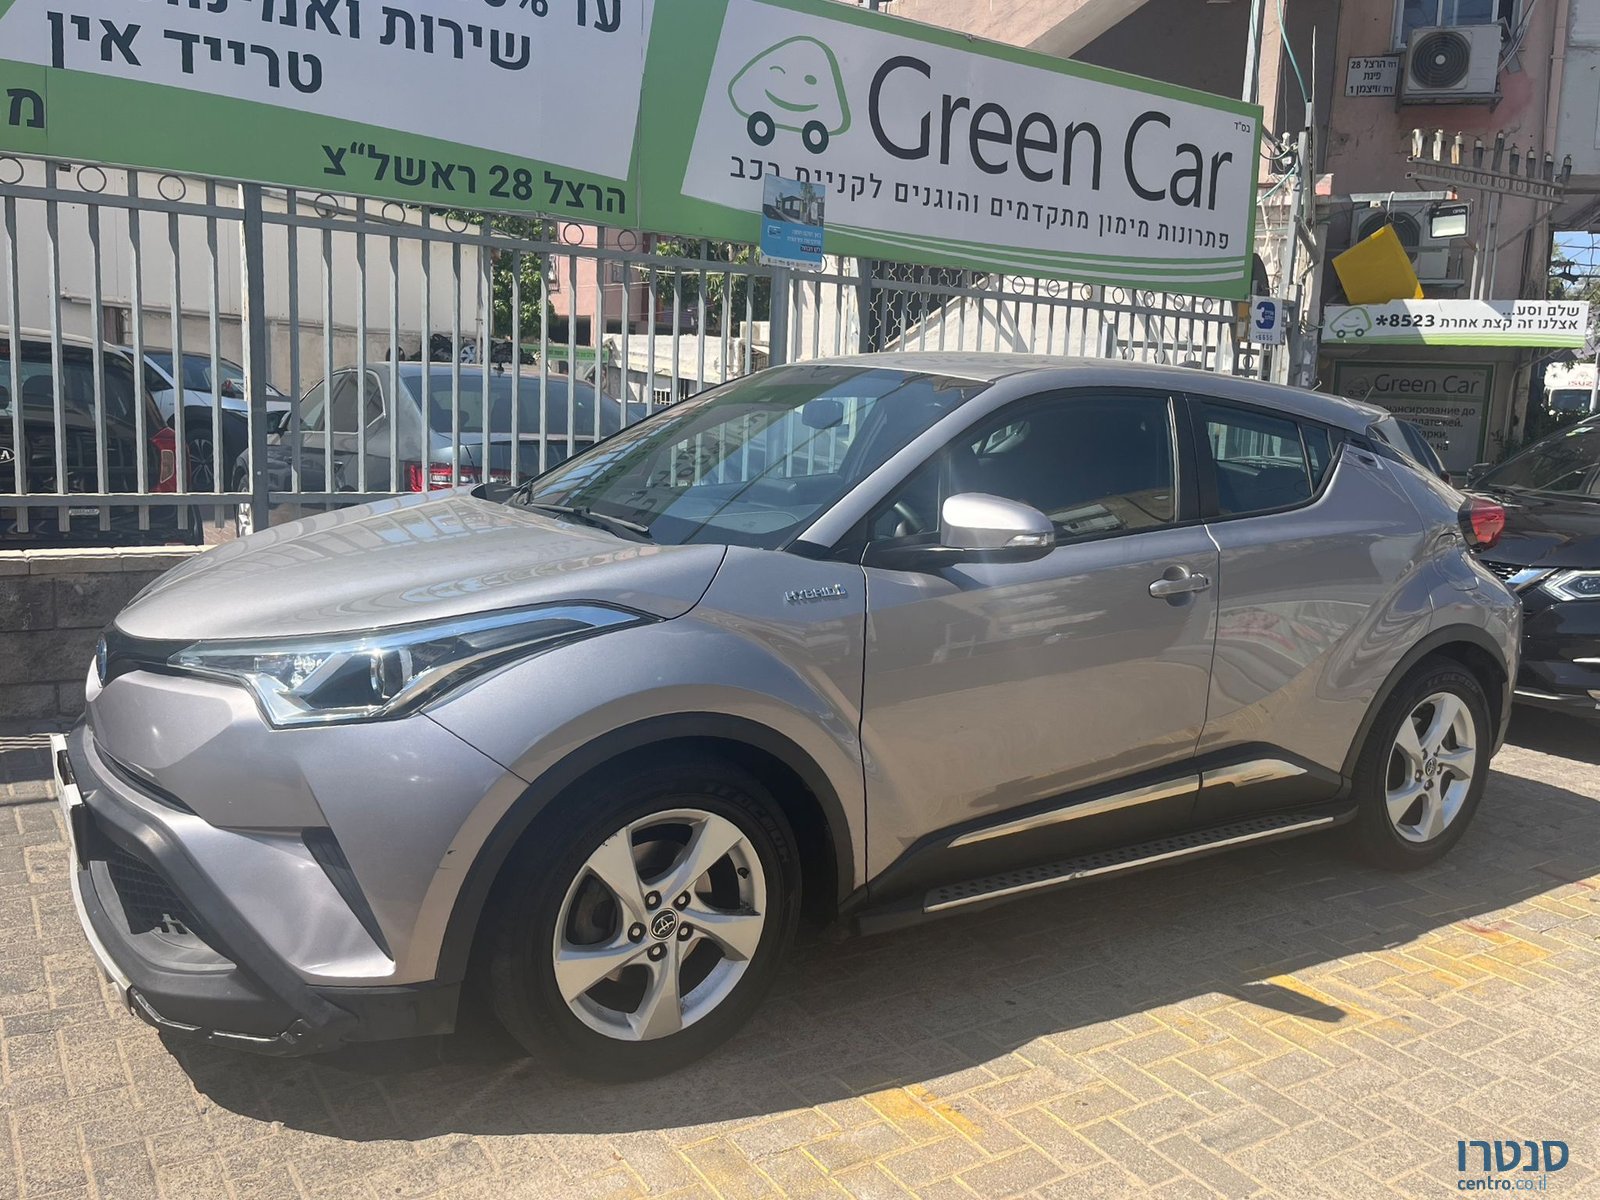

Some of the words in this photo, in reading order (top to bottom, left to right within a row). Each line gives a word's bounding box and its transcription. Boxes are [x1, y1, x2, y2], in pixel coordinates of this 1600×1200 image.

[47, 11, 142, 69] אין
[380, 6, 531, 70] שירות
[163, 29, 323, 94] טרייד
[1351, 60, 1361, 69] 28
[1364, 59, 1386, 69] הרצל
[1363, 72, 1382, 81] פינת
[1350, 85, 1354, 93] 1
[869, 55, 1102, 191] Green
[1124, 110, 1233, 211] Car
[488, 165, 533, 201] 28
[544, 170, 626, 214] הרצל
[895, 182, 979, 214] והוגנים
[990, 197, 1089, 230] מתקדמים
[1099, 214, 1149, 238] מימון
[1157, 223, 1229, 250] פתרונות
[1547, 304, 1580, 317] שלם
[1439, 318, 1479, 328] אחרת
[1482, 319, 1513, 331] קצת
[1517, 319, 1534, 329] זה
[1538, 317, 1578, 330] אצלנו
[1374, 373, 1436, 393] Green
[1443, 375, 1480, 394] Car
[1462, 407, 1476, 416] до
[784, 584, 846, 601] HYBRID
